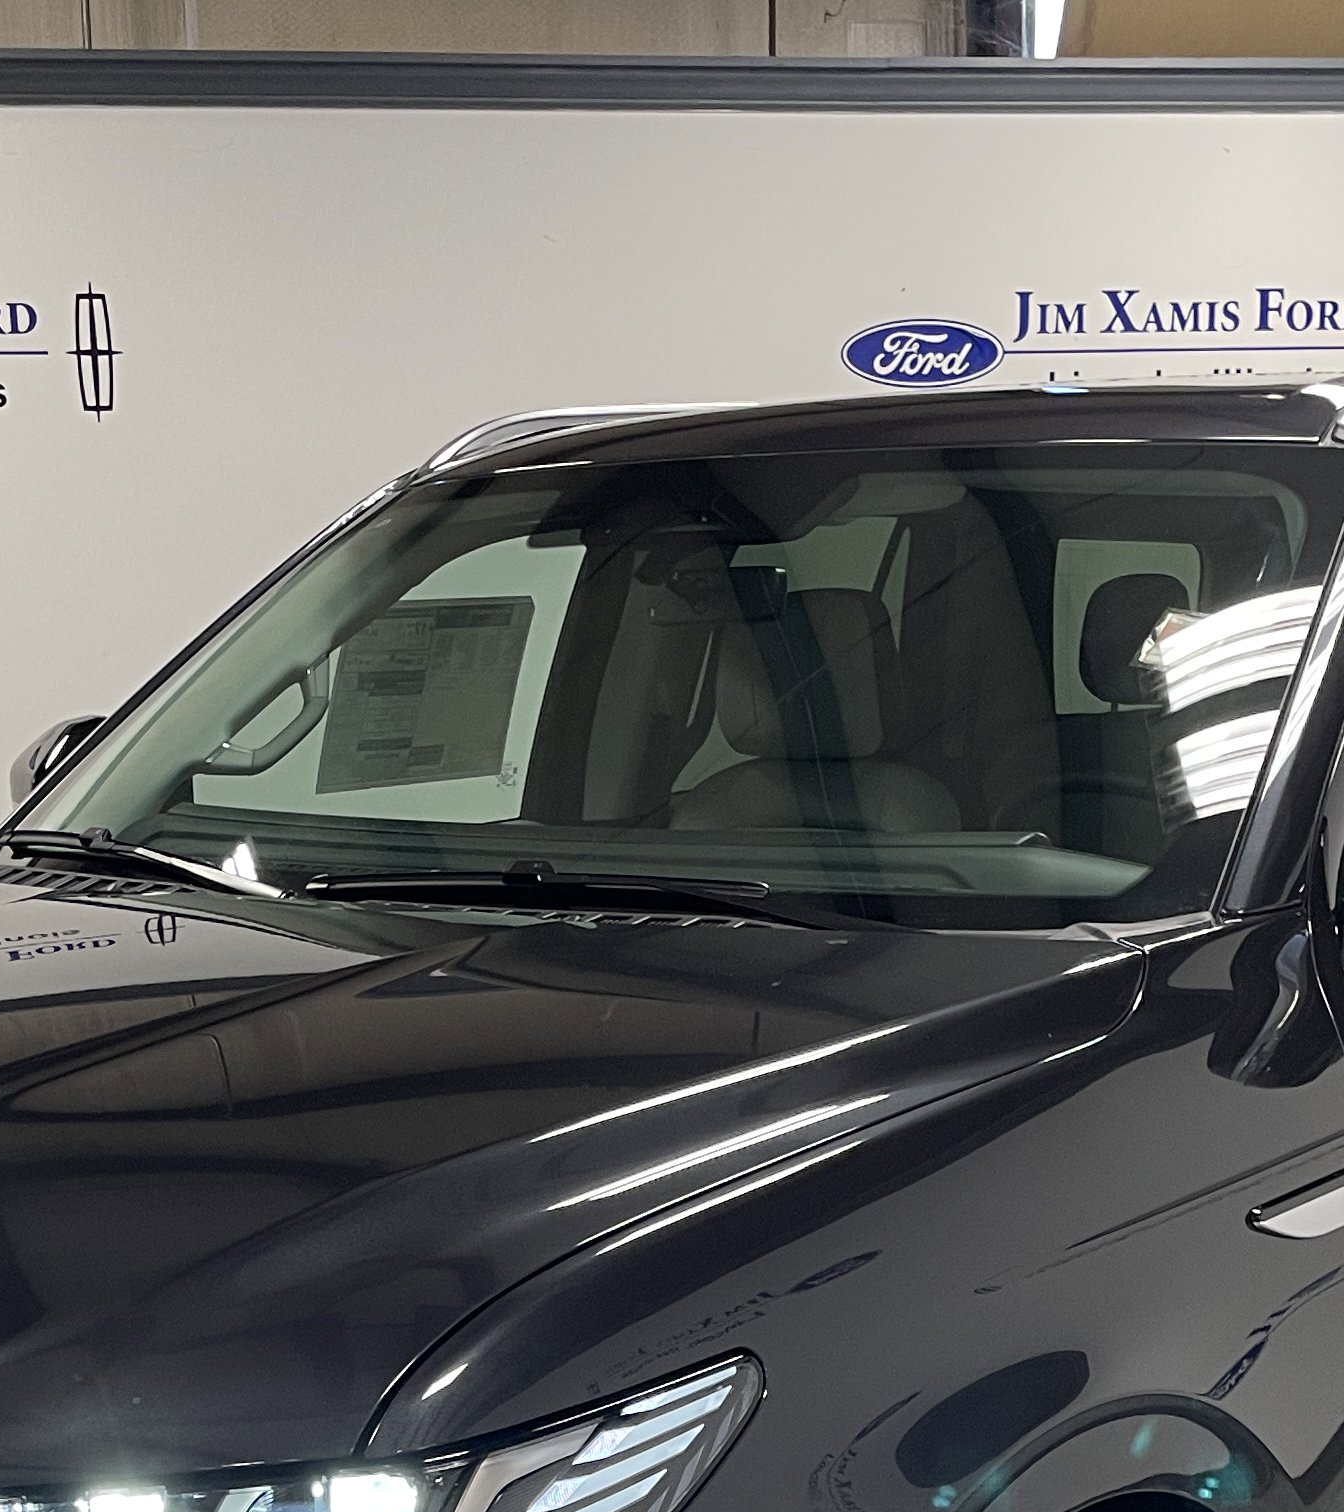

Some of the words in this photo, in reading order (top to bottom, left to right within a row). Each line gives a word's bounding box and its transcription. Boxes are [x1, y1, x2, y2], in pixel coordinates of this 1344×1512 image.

[1013, 290, 1087, 343] JIM
[1100, 289, 1241, 334] XAMIS
[873, 331, 972, 378] Ford
